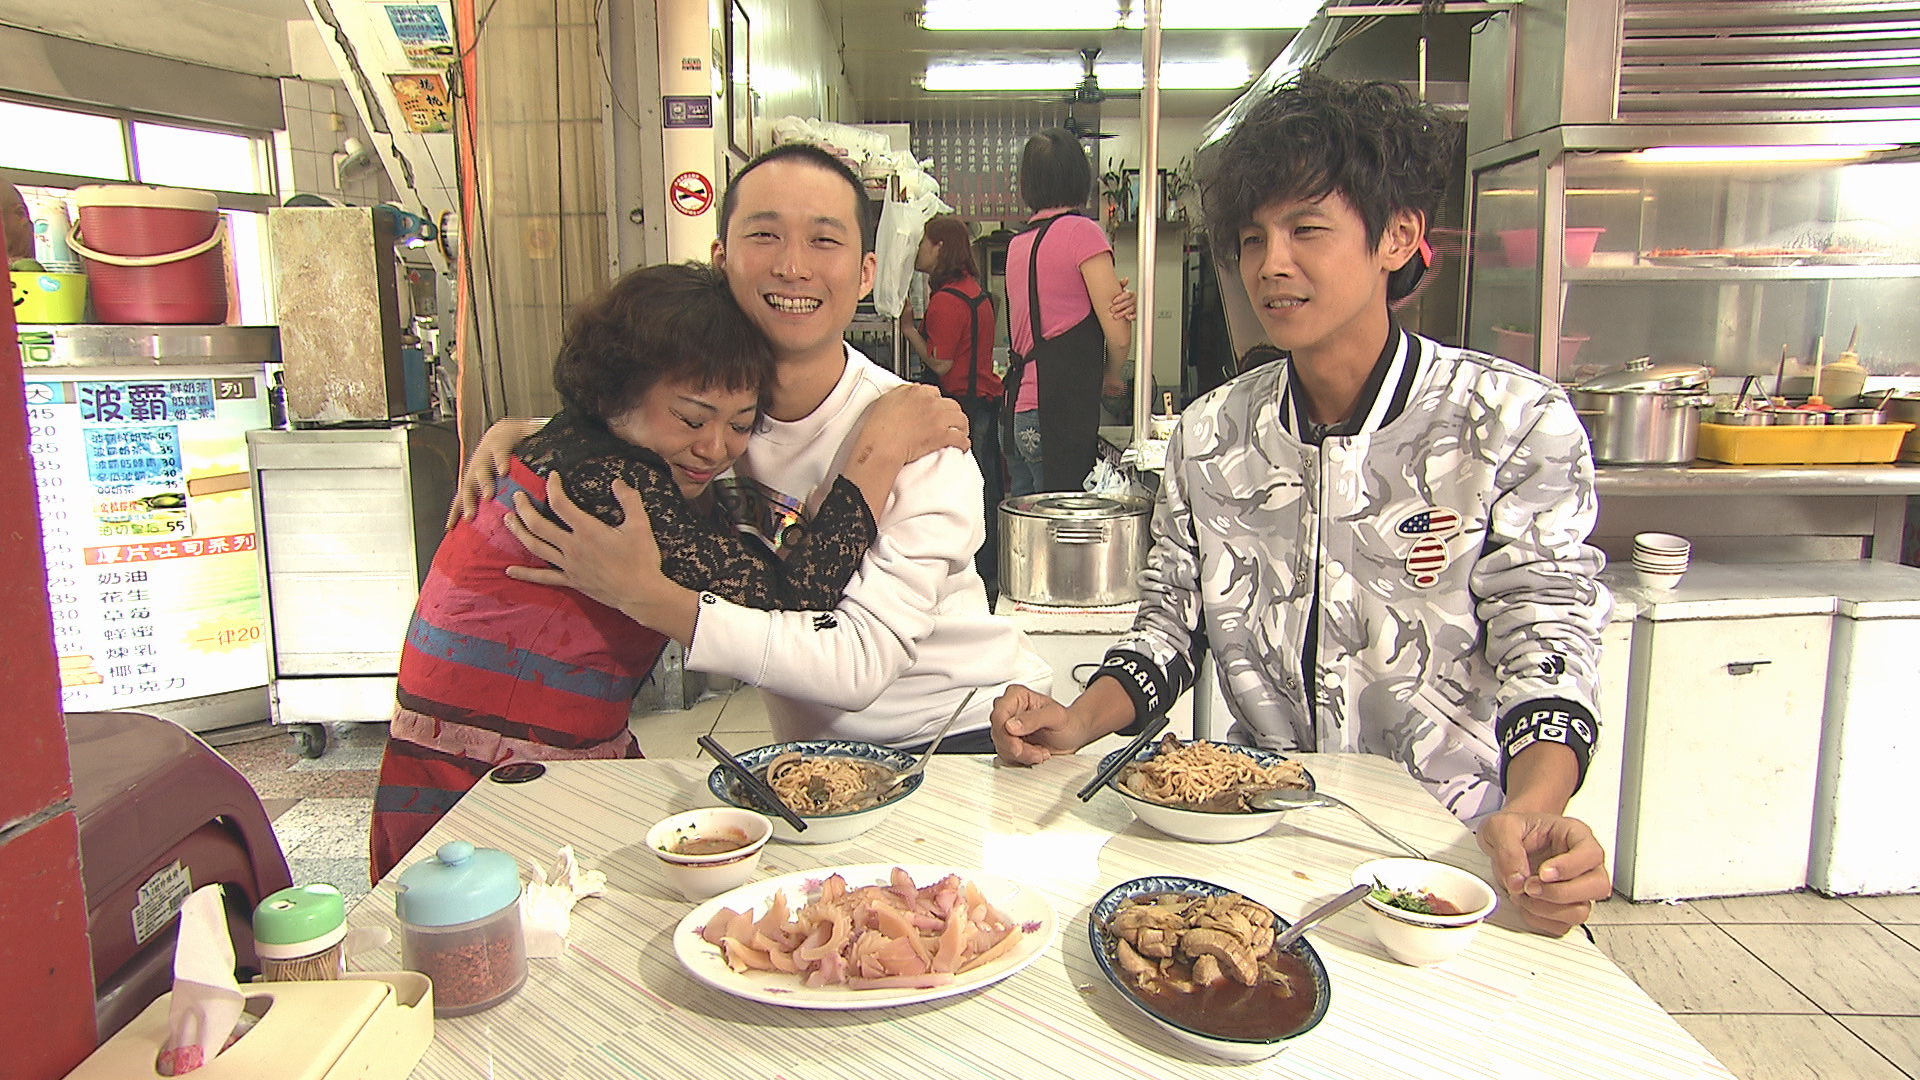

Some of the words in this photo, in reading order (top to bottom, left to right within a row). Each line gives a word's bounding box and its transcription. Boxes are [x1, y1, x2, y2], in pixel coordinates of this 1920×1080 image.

[170, 382, 208, 395] 鮮奶茶
[221, 382, 244, 399] 列
[81, 384, 167, 423] 波霸
[31, 425, 56, 437] 20
[158, 431, 173, 441] 45
[32, 442, 59, 454] 35
[93, 446, 143, 458] 波霸奶茶
[160, 445, 175, 455] 35
[35, 460, 61, 471] 35
[162, 457, 176, 467] 30
[164, 469, 177, 478] 30
[37, 477, 62, 487] 30
[164, 480, 178, 489] 35
[167, 520, 185, 533] 55
[97, 534, 256, 564] 厚片吐司系列
[50, 577, 76, 588] 25
[98, 569, 148, 585] 奶油
[51, 593, 77, 605] 35
[100, 588, 151, 604] 花生
[54, 609, 79, 621] 30
[104, 606, 151, 622] 草莓
[56, 625, 81, 637] 35
[104, 625, 154, 641] 蜂蜜
[196, 626, 260, 646] 一律20
[112, 677, 185, 696] 巧克力
[1122, 660, 1159, 712] AAPE
[1504, 710, 1570, 747] AAPE
